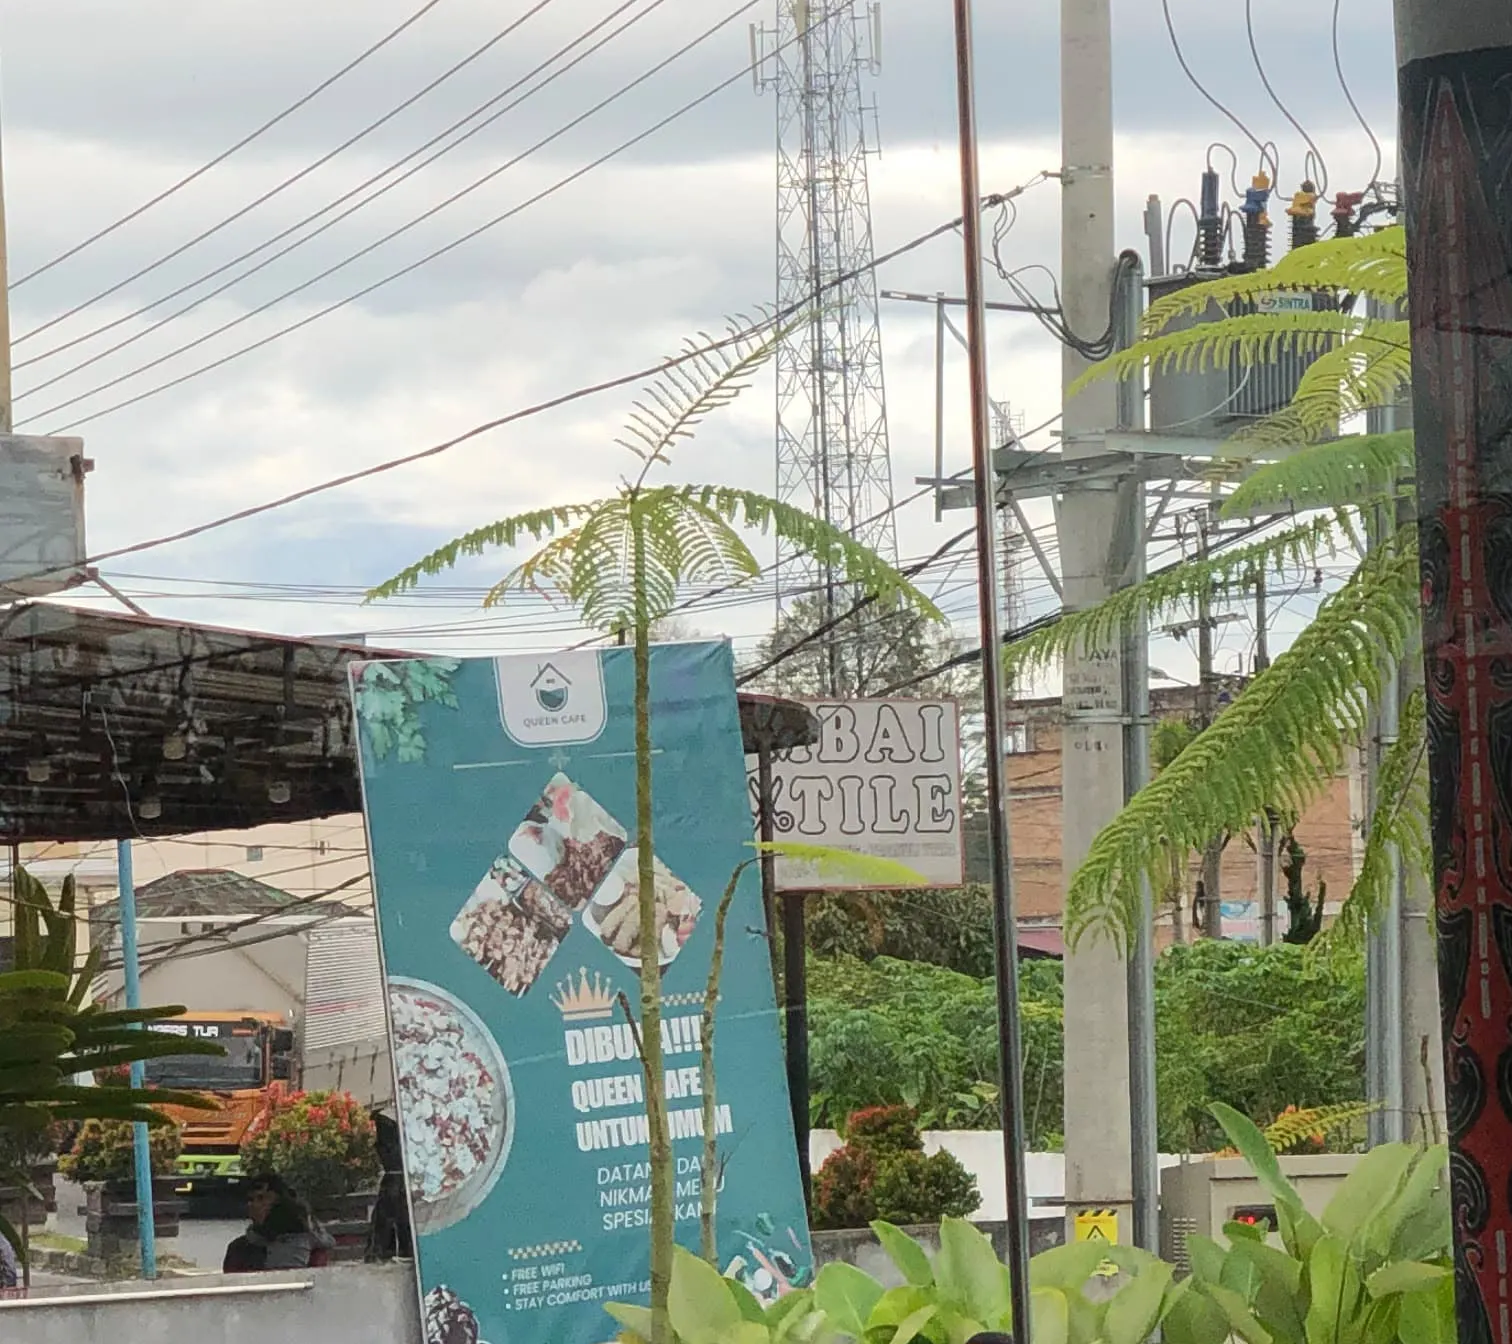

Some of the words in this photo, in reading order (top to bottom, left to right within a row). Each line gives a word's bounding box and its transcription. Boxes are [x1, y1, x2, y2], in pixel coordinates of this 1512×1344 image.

[523, 715, 558, 729] QUEEN
[561, 714, 586, 725] CAFE
[770, 705, 945, 764] BAI
[571, 1074, 643, 1113] QUEEN
[664, 1066, 703, 1100] AFE
[677, 1155, 705, 1175] DA
[600, 1184, 653, 1208] NIKMA
[676, 1175, 725, 1198] MEU
[603, 1208, 653, 1231] SPESI
[511, 1266, 537, 1281] FREE
[541, 1262, 565, 1277] WIFI
[513, 1281, 541, 1295] FREE
[542, 1274, 592, 1290] PARKING
[515, 1296, 544, 1310] STAY
[547, 1286, 603, 1306] COMFORT
[607, 1282, 637, 1297] WITH
